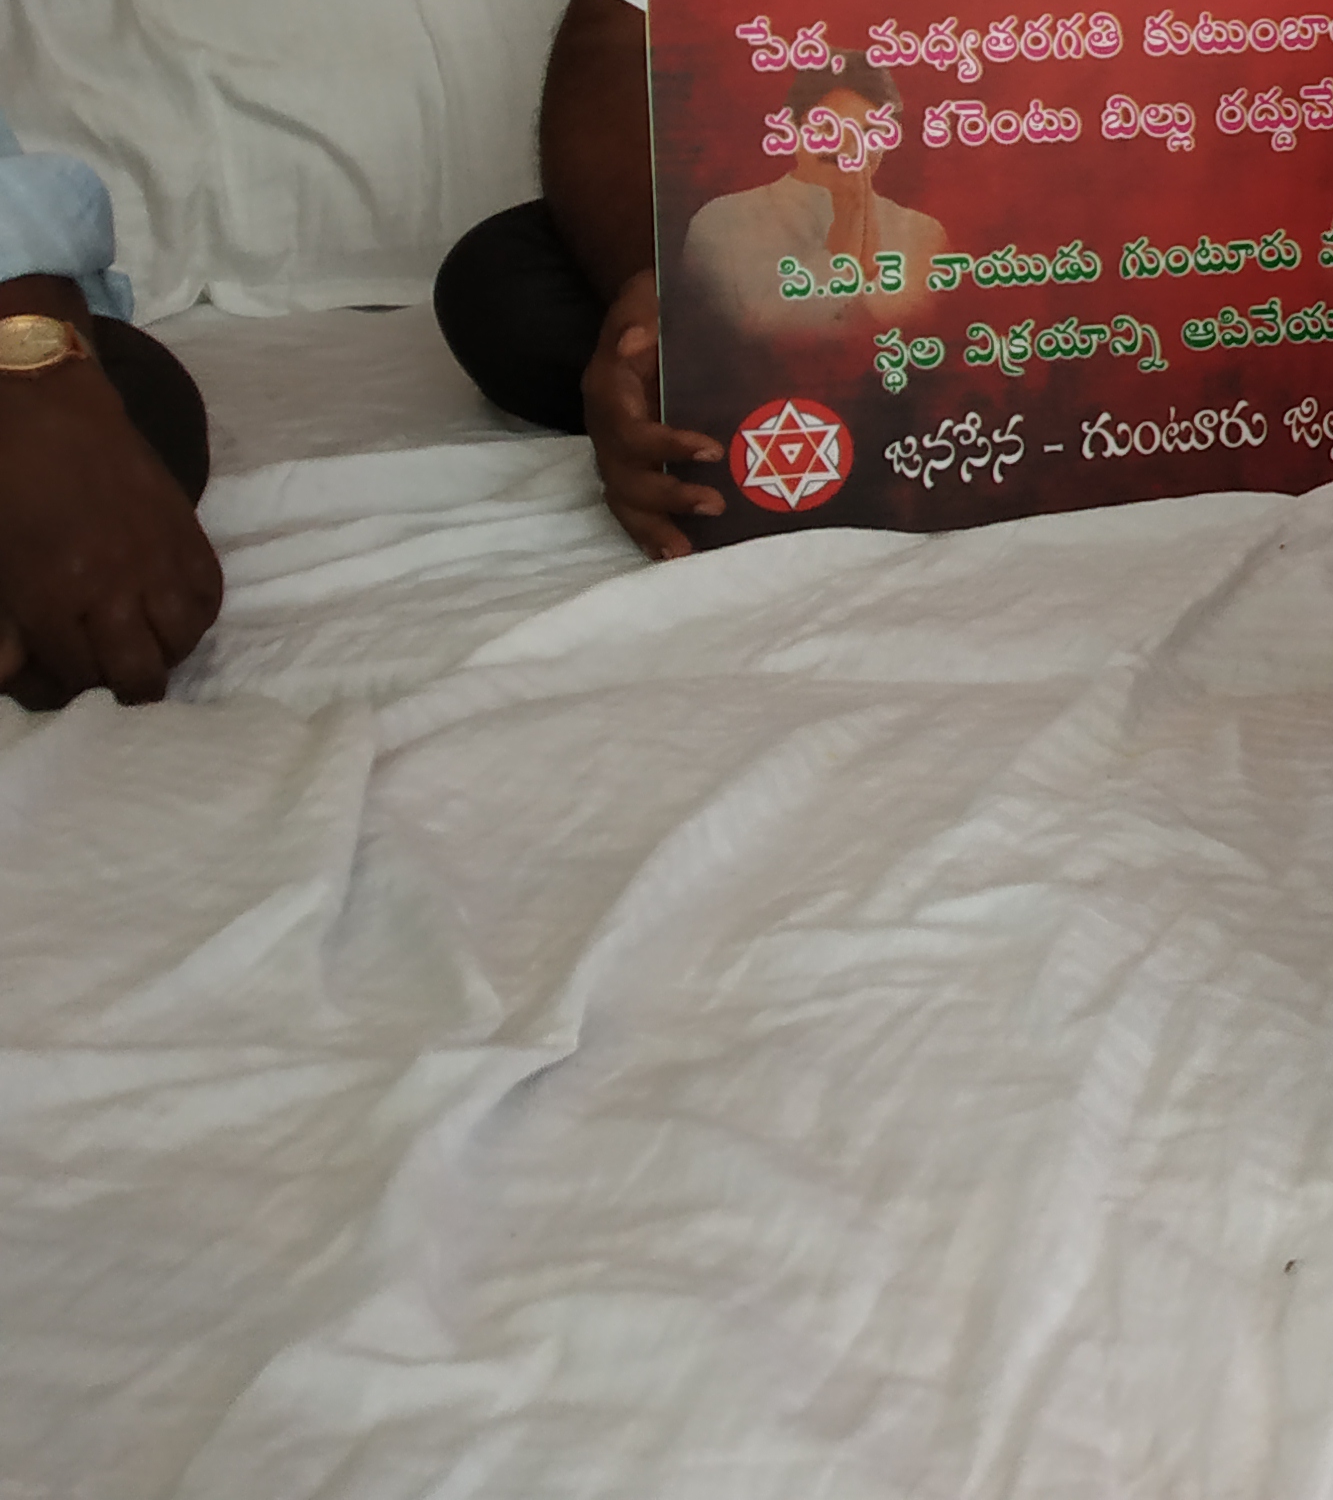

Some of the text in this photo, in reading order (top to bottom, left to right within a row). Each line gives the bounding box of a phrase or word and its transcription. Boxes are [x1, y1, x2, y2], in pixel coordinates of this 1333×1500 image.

[737, 17, 845, 72] పేద,
[867, 13, 1122, 82] మధ్యతరగతి
[763, 105, 901, 171] వచ్చిన
[923, 99, 1081, 147] కరెంటు
[1101, 95, 1194, 151] బిల్లు
[927, 240, 1101, 290] నాయుడు
[1120, 230, 1301, 278] గుంటూరు
[874, 328, 945, 393] స్థల
[964, 315, 1168, 372] విక్రయాన్ని
[884, 412, 1024, 488] జనసేన
[1080, 400, 1267, 460] గుంటూరు
